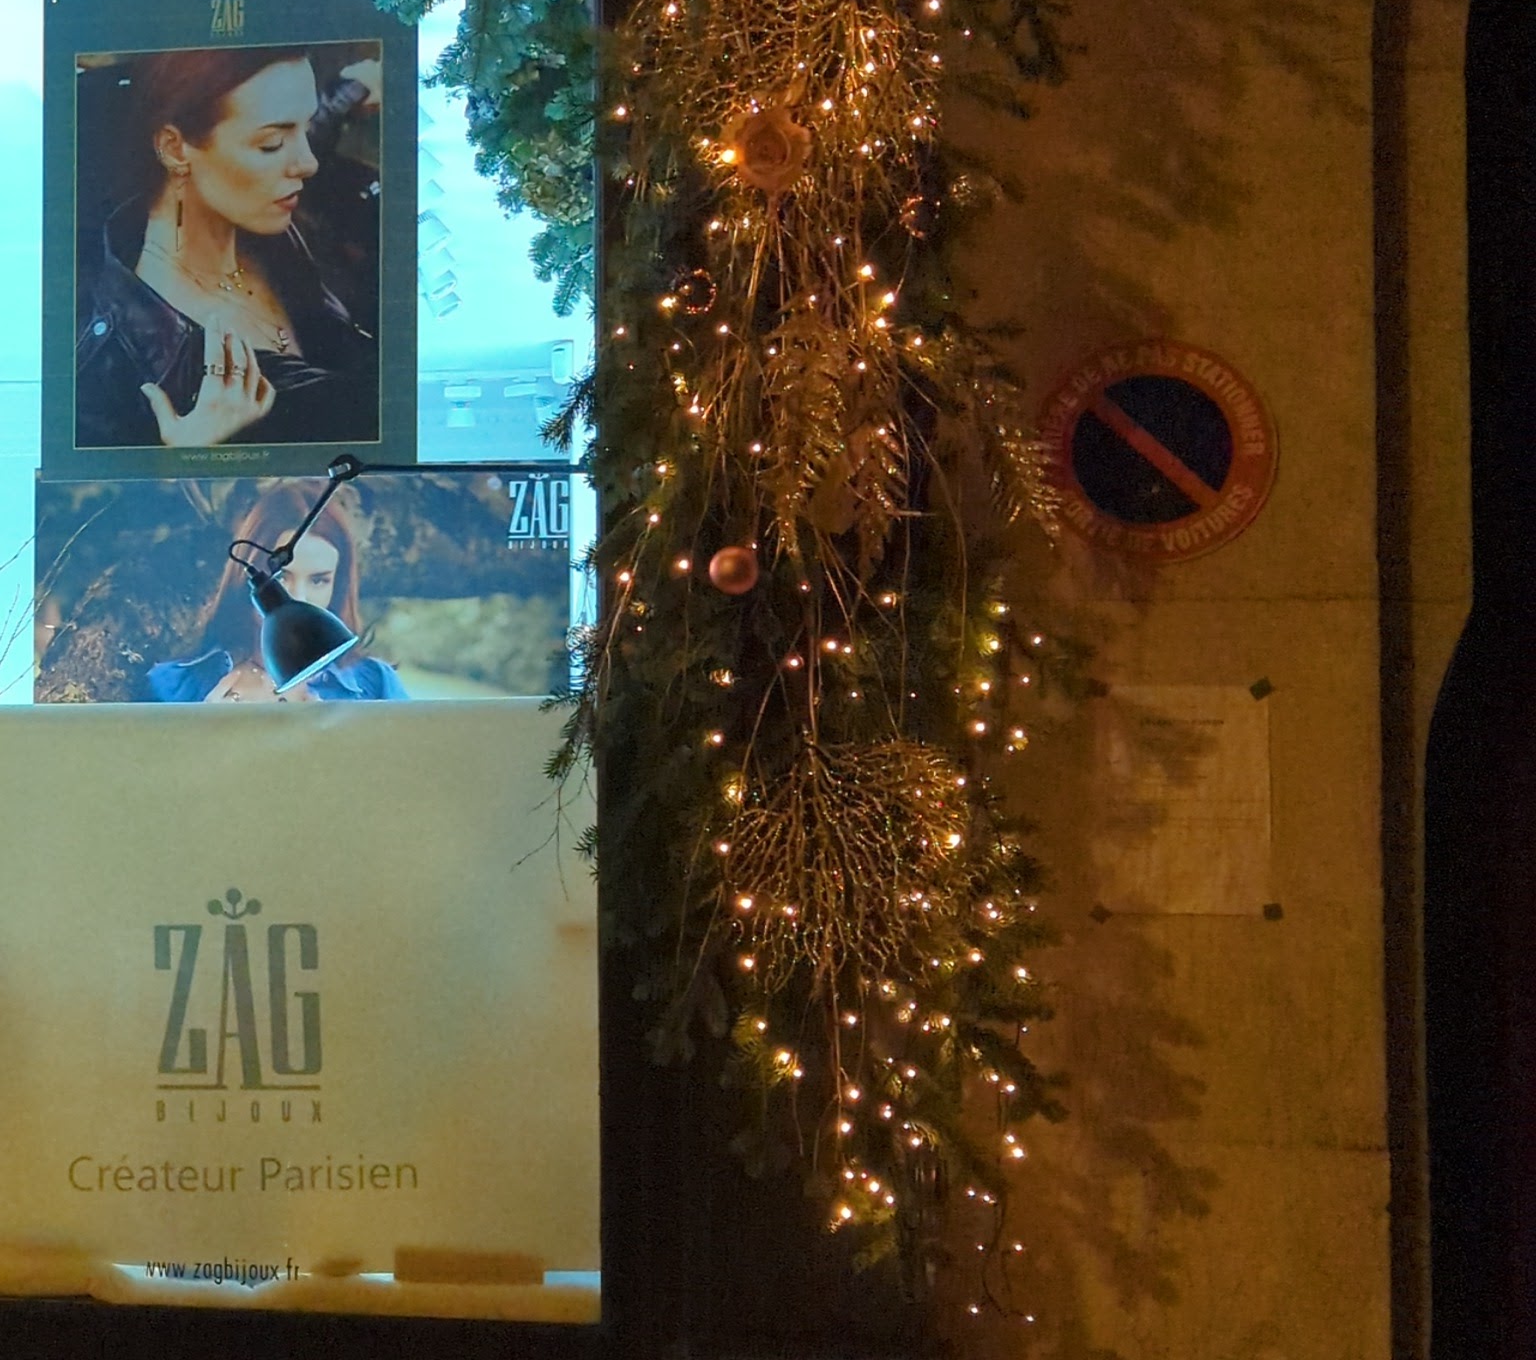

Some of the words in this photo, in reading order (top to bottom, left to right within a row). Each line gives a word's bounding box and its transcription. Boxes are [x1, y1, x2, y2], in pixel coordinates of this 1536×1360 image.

[1182, 351, 1265, 456] STATIONNER
[509, 480, 569, 538] ZAG
[1060, 490, 1124, 546] ORTIE
[1160, 484, 1253, 552] VOITURES
[154, 923, 323, 1090] ZAG
[156, 1100, 322, 1123] BIJOUX
[68, 1153, 244, 1192] Créateur
[259, 1154, 419, 1192] Parisien
[146, 1256, 299, 1285] wwwzagbijouxfr
